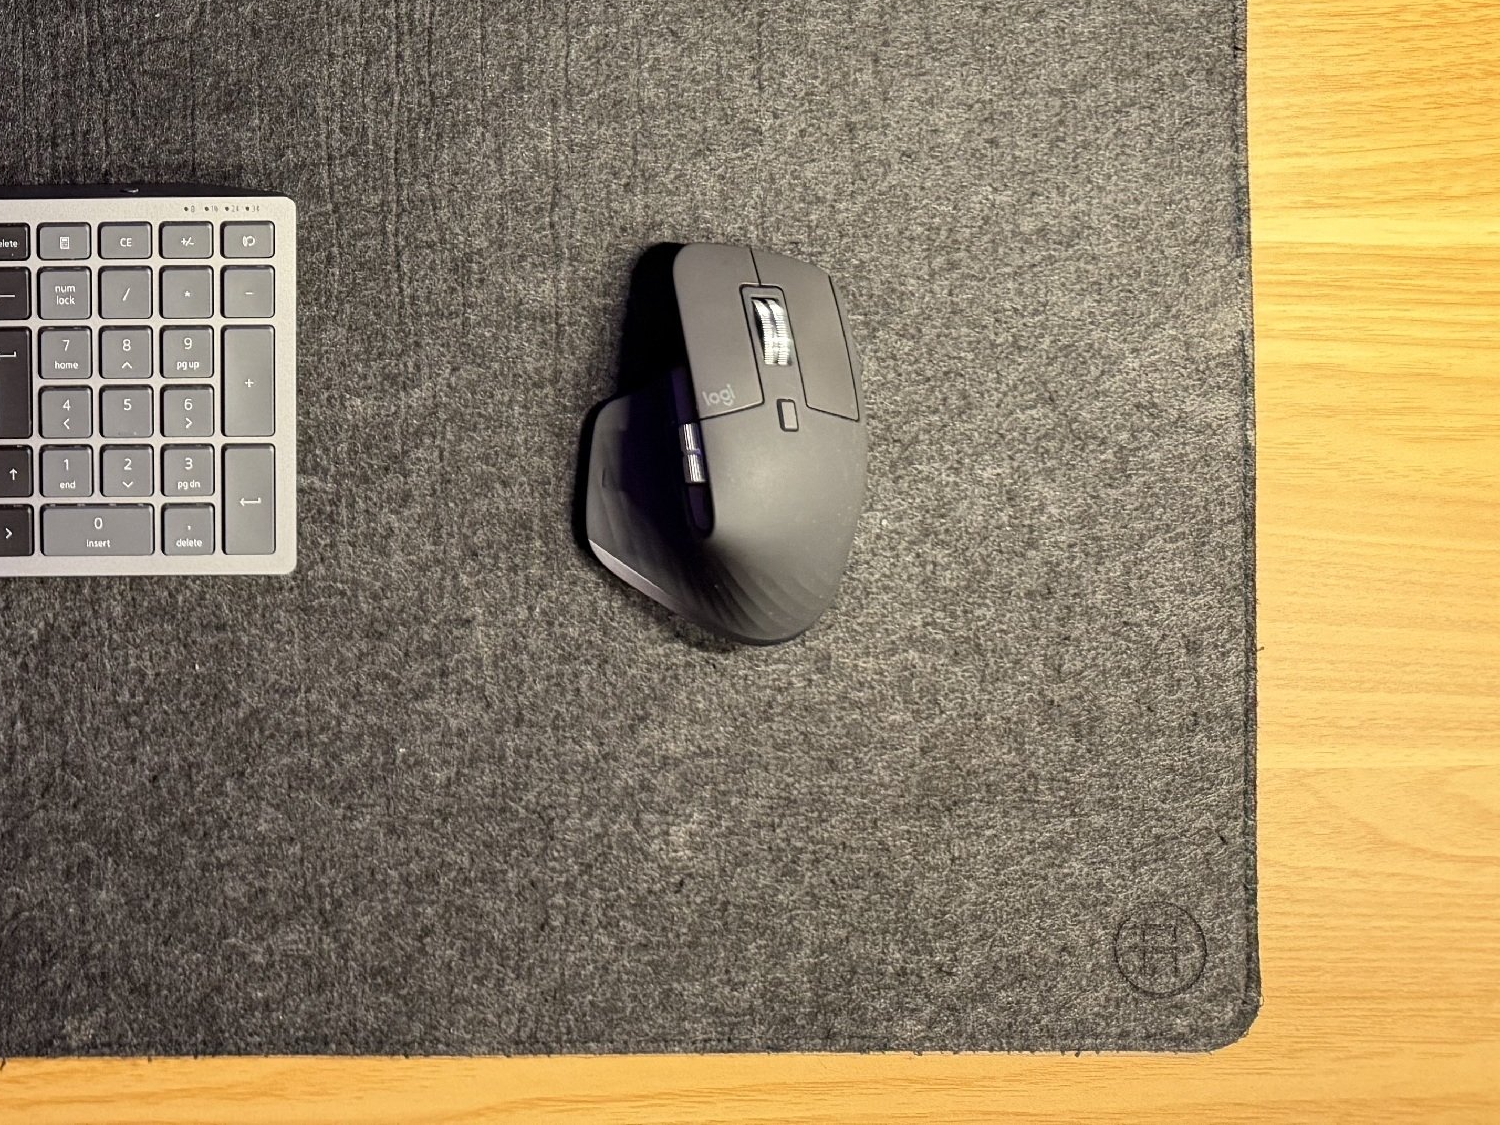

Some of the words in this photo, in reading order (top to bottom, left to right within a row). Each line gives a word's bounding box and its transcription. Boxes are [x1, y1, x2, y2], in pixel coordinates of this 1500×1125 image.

[119, 237, 133, 248] CE
[54, 285, 76, 294] num
[56, 294, 76, 306] lock
[62, 339, 70, 352] 7
[122, 338, 132, 352] 8
[183, 337, 193, 350] 9
[54, 360, 79, 370] home
[176, 361, 188, 371] pg
[188, 361, 200, 371] up
[702, 384, 736, 407] logi
[62, 399, 71, 412] 4
[123, 398, 132, 411] 5
[184, 398, 193, 411] 6
[123, 457, 133, 471] 2
[184, 457, 193, 471] 3
[59, 480, 76, 489] end
[177, 481, 188, 491] pg
[188, 479, 201, 490] dn
[94, 517, 103, 530] 0
[86, 539, 111, 548] insert
[175, 537, 203, 548] delete
